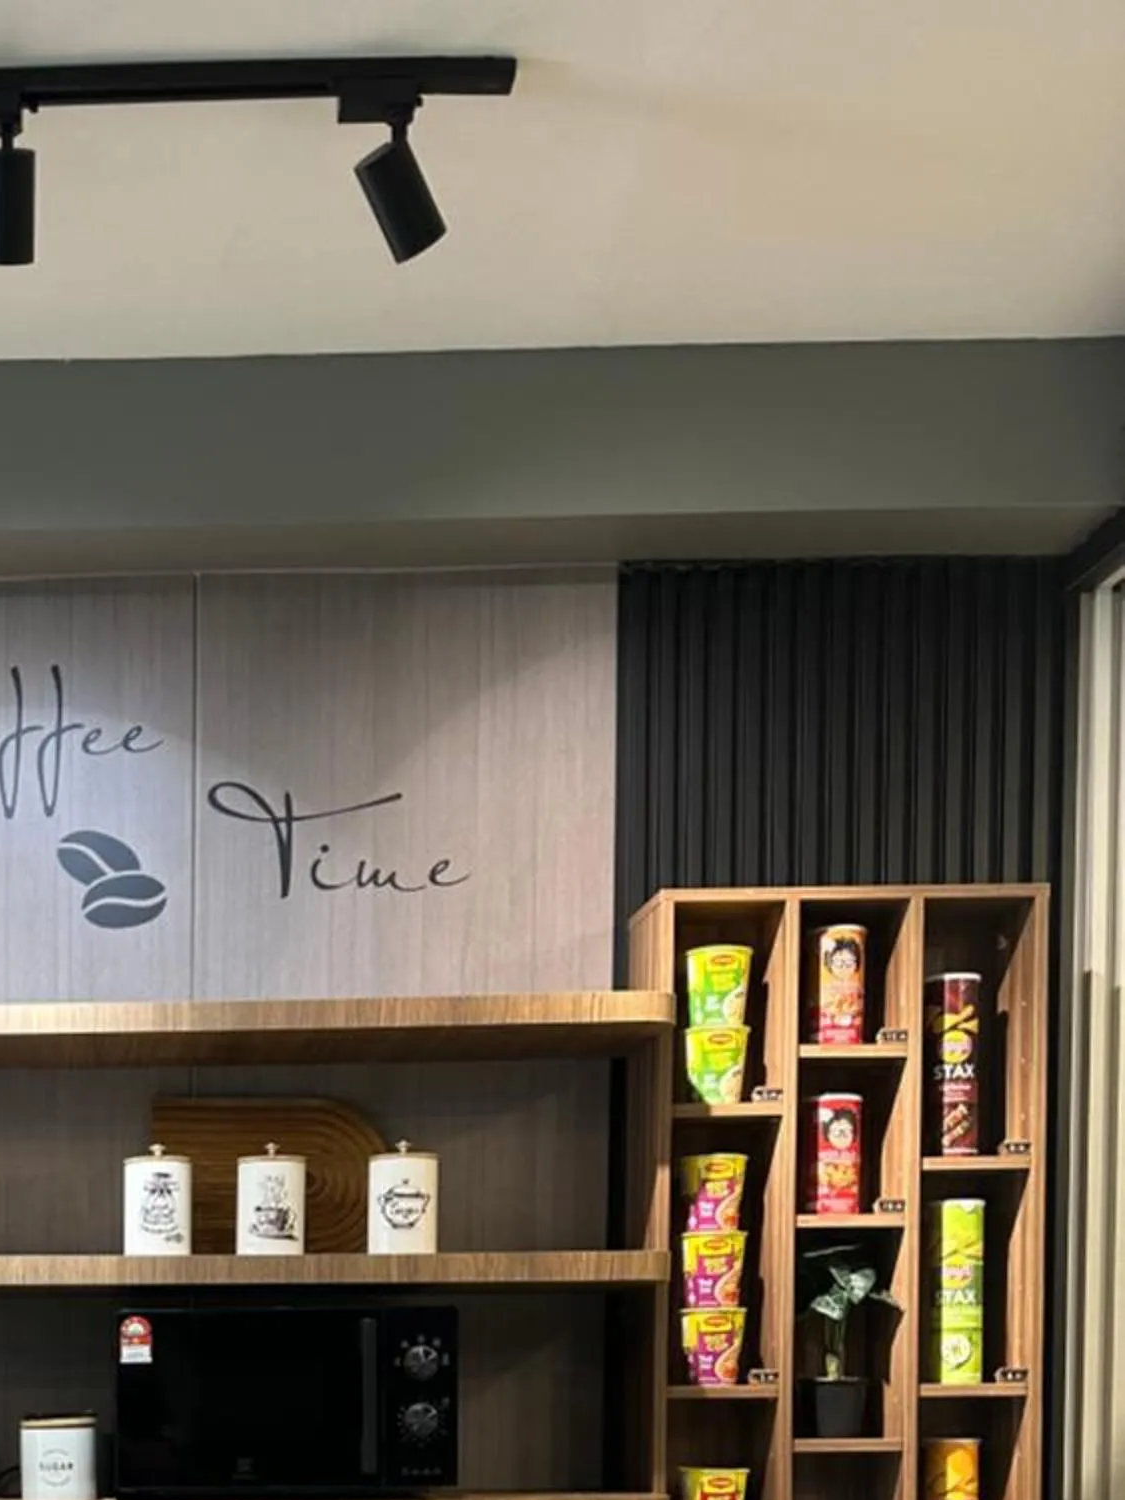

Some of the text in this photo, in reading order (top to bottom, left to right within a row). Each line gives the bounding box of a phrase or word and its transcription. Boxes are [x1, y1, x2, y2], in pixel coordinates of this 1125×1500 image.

[206, 781, 472, 899] Time
[933, 1064, 975, 1079] STAX
[39, 1461, 75, 1471] SUGAR
